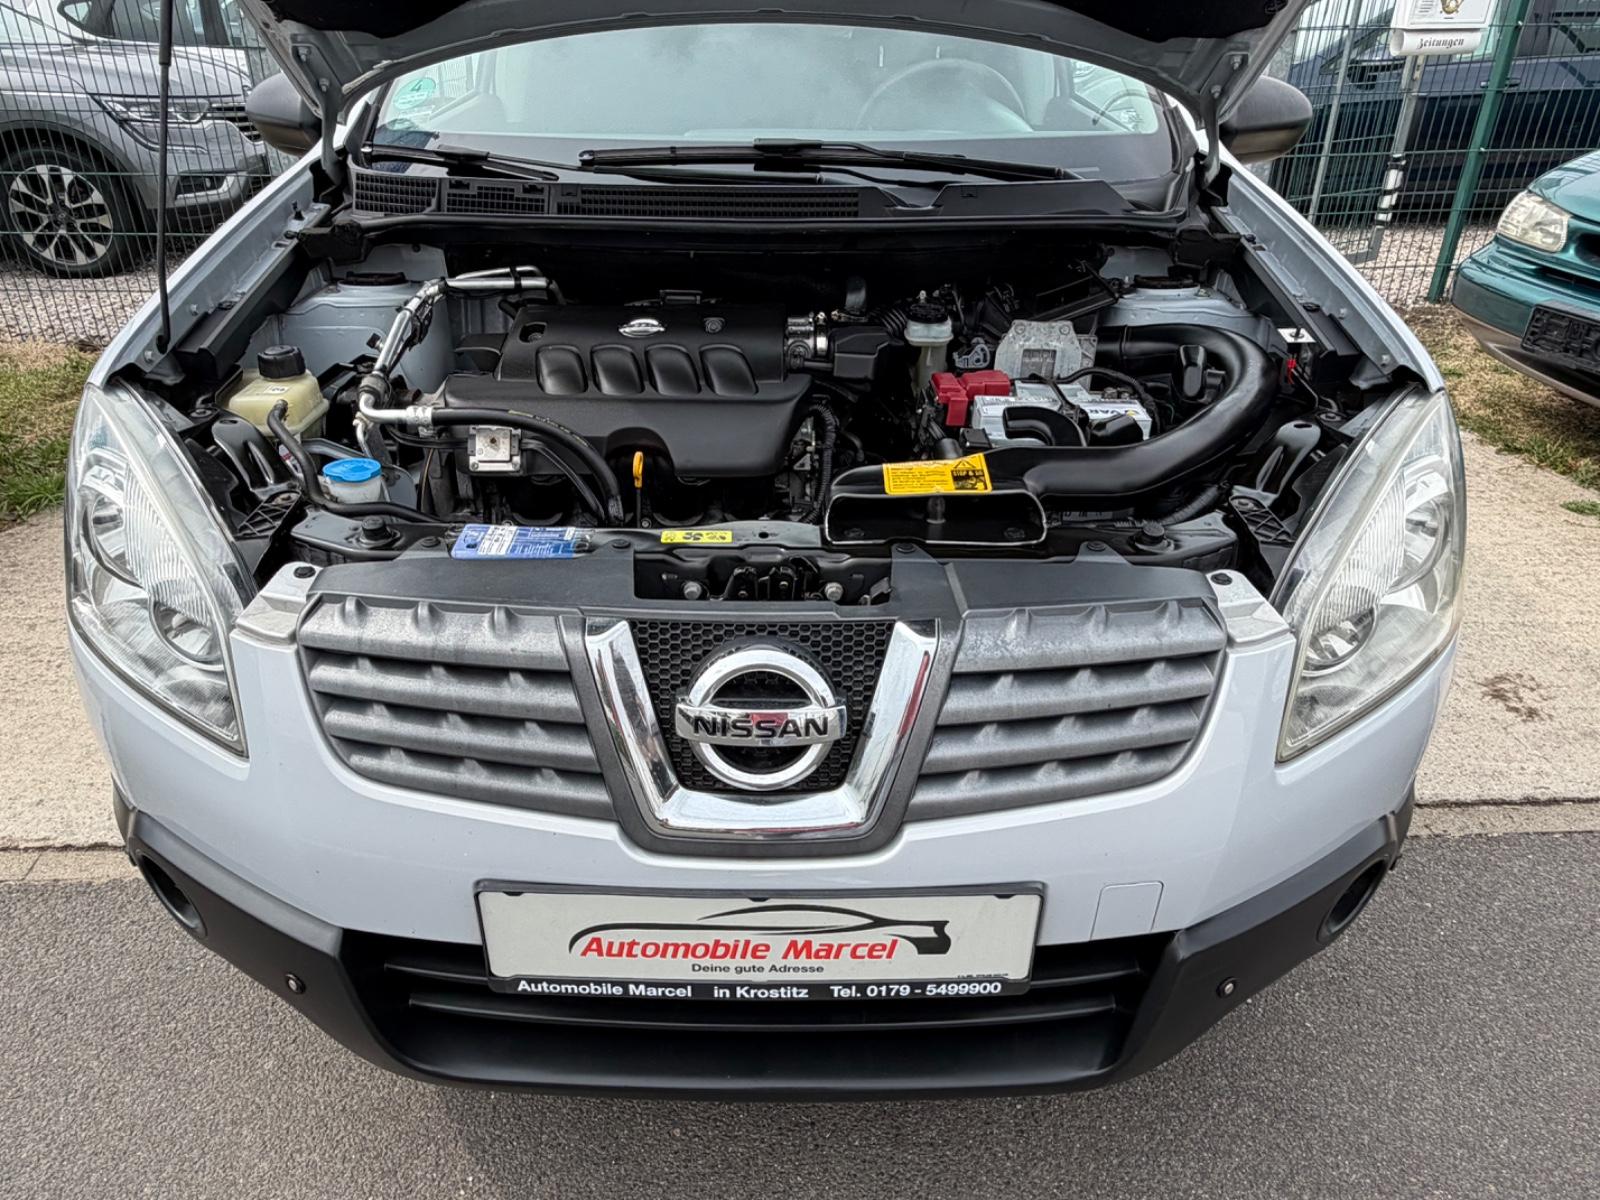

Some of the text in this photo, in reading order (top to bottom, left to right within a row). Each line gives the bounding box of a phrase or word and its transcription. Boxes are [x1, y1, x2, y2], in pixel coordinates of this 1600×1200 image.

[1417, 37, 1465, 49] Zeitungen
[693, 716, 828, 738] NISSAN
[580, 936, 898, 960] Automobile Marcel
[691, 963, 824, 975] Deine gute Adresse
[517, 979, 623, 996] Automobile
[629, 983, 692, 997] Marcel
[713, 985, 731, 998] in
[736, 986, 809, 998] Krostitz
[830, 985, 861, 997] Tel.
[866, 983, 911, 997] 0179
[925, 982, 1002, 996] 5499900
